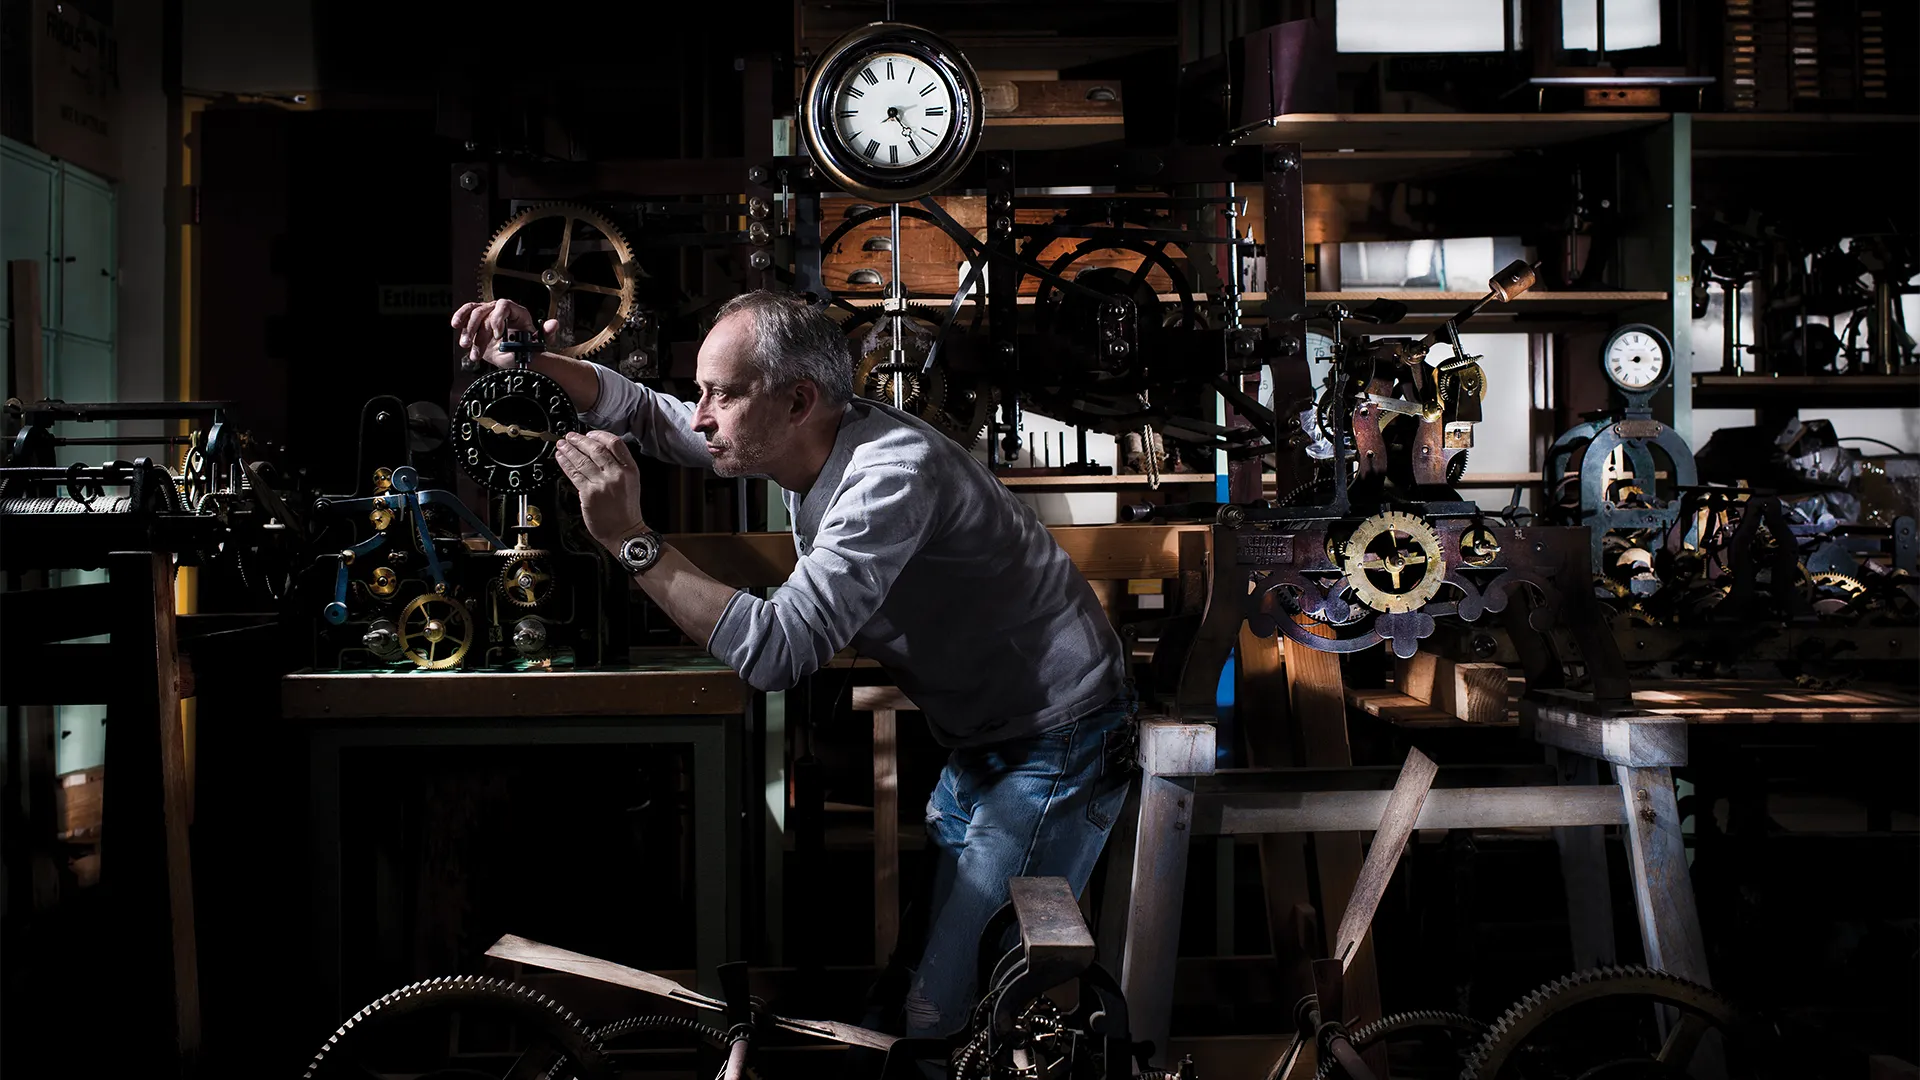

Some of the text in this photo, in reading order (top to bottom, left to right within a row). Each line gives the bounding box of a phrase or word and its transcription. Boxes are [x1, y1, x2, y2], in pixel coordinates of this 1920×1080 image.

[481, 382, 497, 400] 11
[504, 375, 525, 394] 12
[532, 381, 541, 400] 1
[463, 400, 482, 418] 10
[549, 395, 561, 415] 2
[461, 422, 473, 441] 9
[467, 447, 479, 466] 8
[484, 465, 497, 483] 7
[508, 470, 521, 488] 6
[532, 463, 544, 481] 5
